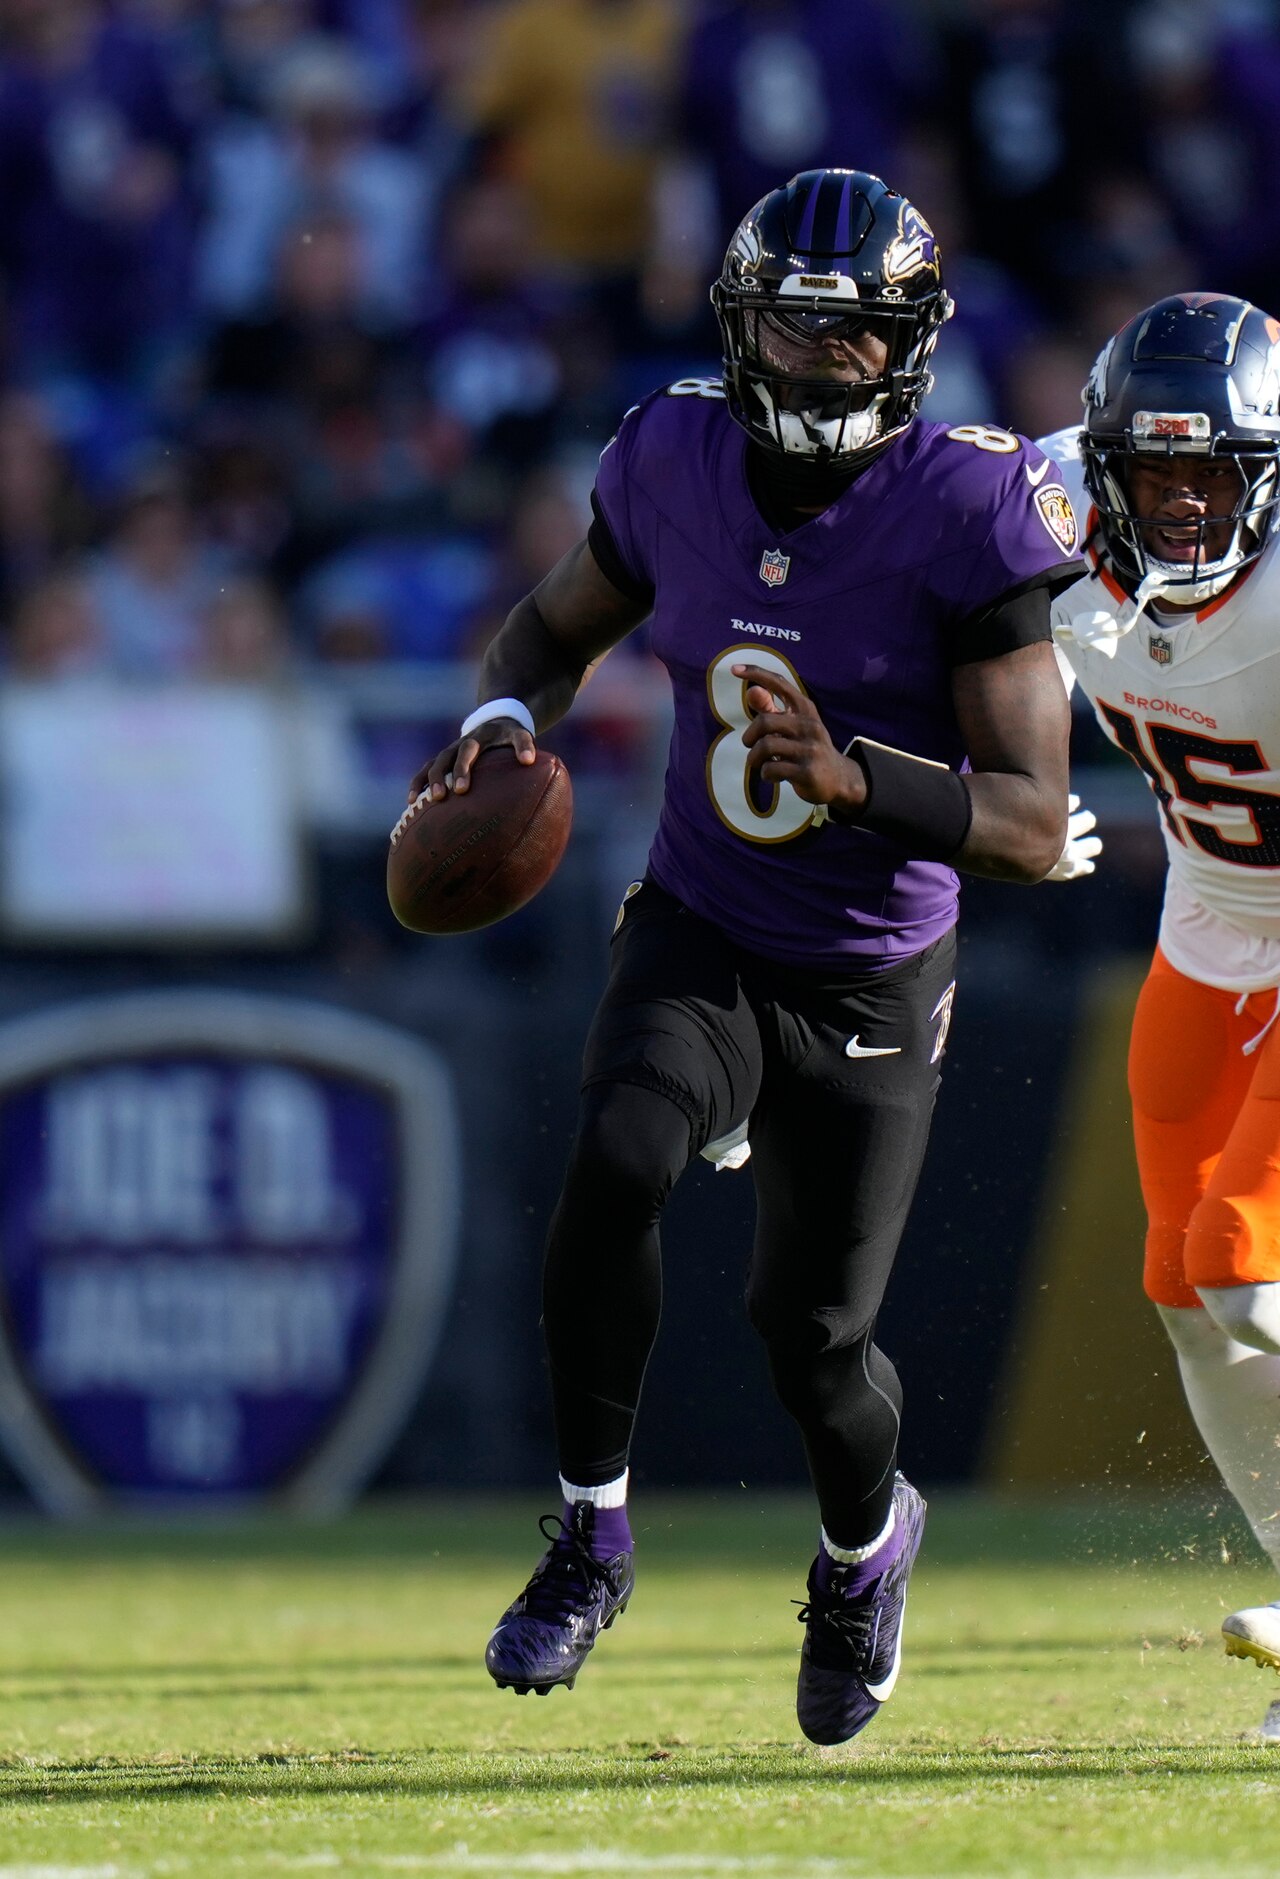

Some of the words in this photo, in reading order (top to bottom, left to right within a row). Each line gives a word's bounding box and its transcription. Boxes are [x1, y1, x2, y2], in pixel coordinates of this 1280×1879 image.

[800, 276, 838, 290] RAVENS
[667, 378, 728, 398] 8
[1154, 418, 1190, 434] 5280
[947, 425, 1023, 454] 8
[764, 564, 783, 581] NFL
[731, 618, 802, 642] RAVENS
[1151, 647, 1169, 662] NFL
[1123, 691, 1217, 729] BRONCOS
[706, 643, 816, 844] 8
